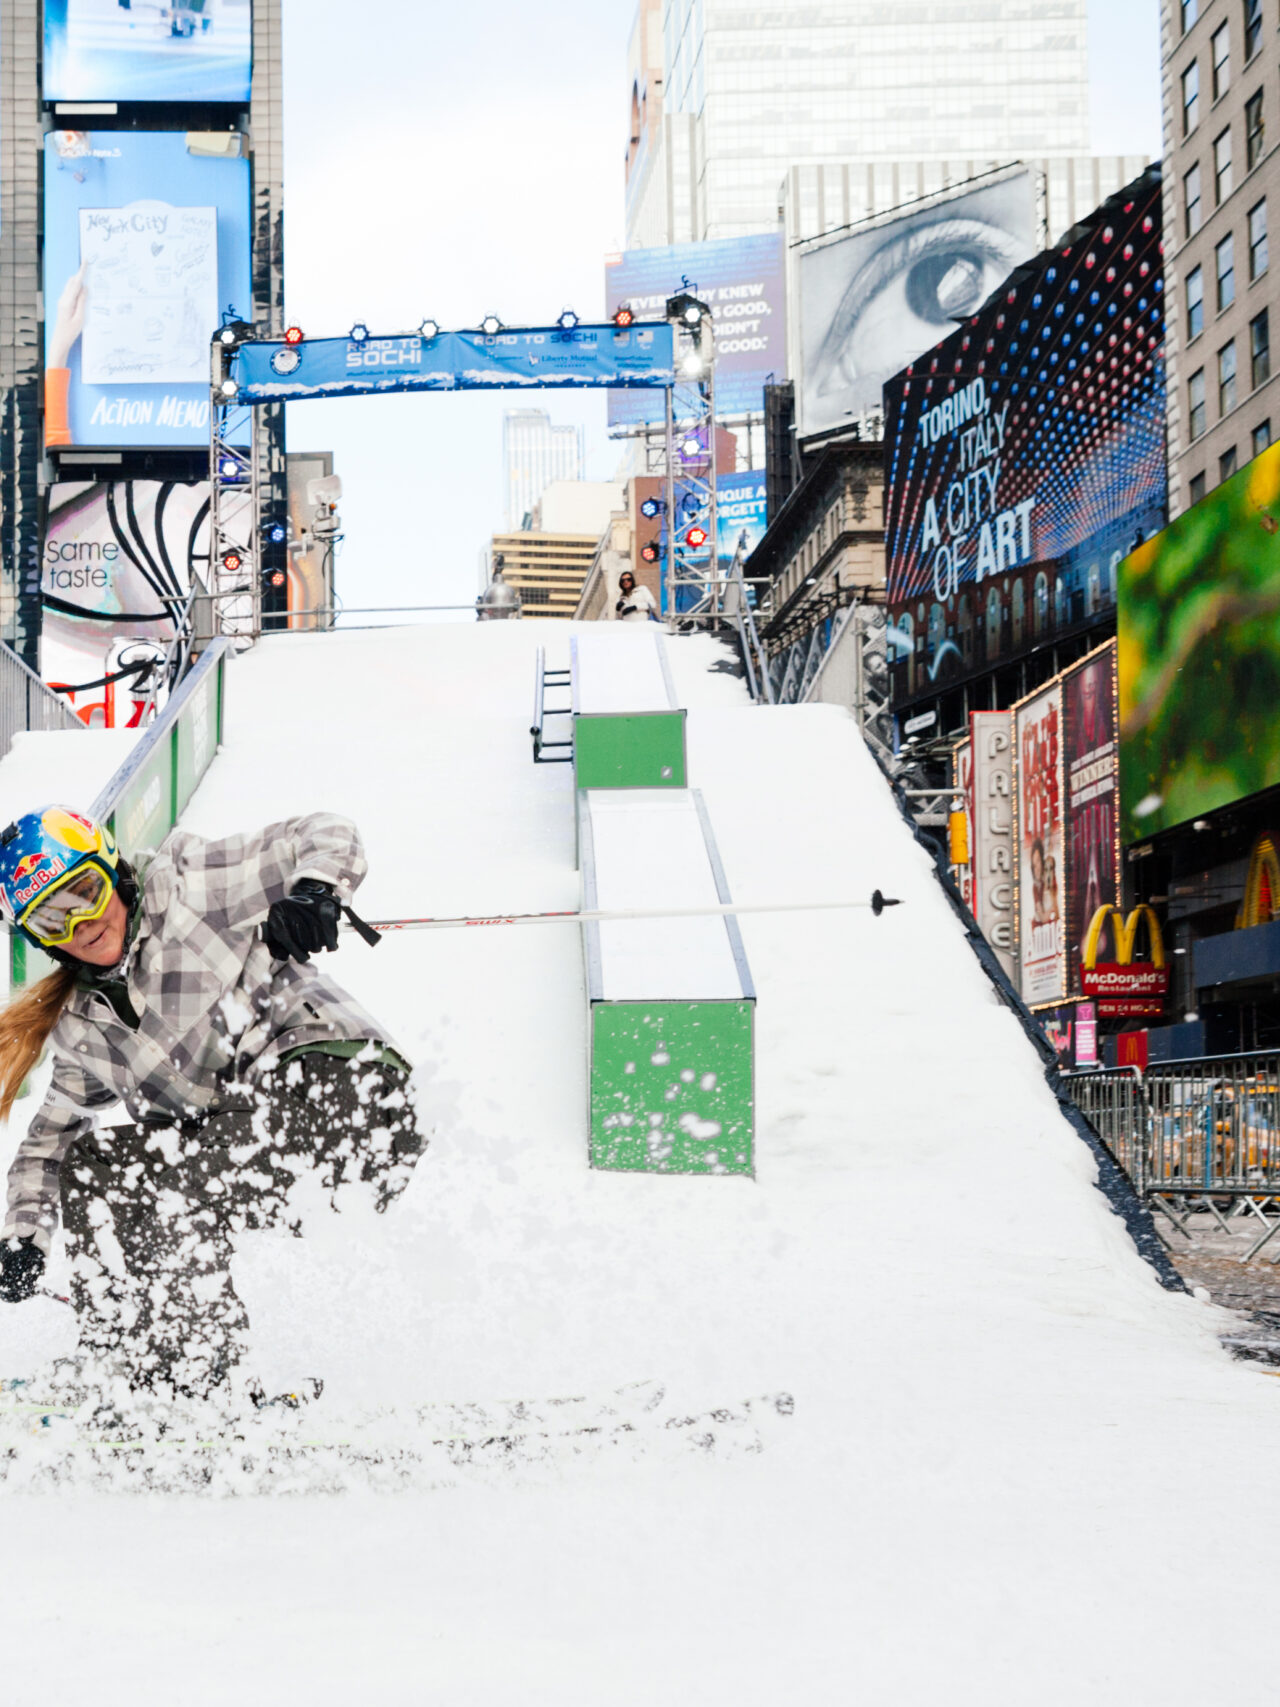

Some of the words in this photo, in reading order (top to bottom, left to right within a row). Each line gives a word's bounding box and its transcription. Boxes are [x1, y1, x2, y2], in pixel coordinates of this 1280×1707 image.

[130, 213, 169, 234] City
[718, 283, 765, 301] KNEW
[722, 300, 772, 319] GOOD,
[346, 339, 393, 353] ROAD
[401, 338, 422, 350] TO
[473, 335, 518, 347] ROAD
[523, 333, 546, 345] TO
[550, 332, 598, 344] SOCHI
[346, 349, 422, 368] SOCHI
[155, 394, 210, 429] MEMO
[919, 376, 991, 449] TORINO,
[959, 405, 1009, 473] ITALY
[922, 497, 941, 553] A
[947, 457, 1002, 537] CITY
[46, 540, 119, 563] Same
[933, 535, 969, 602] OF
[975, 496, 1036, 584] ART
[50, 565, 114, 590] taste.
[988, 730, 1013, 949] PALACE
[14, 878, 41, 905] Red
[37, 855, 66, 885] Bull
[1084, 972, 1166, 984] McDonald's
